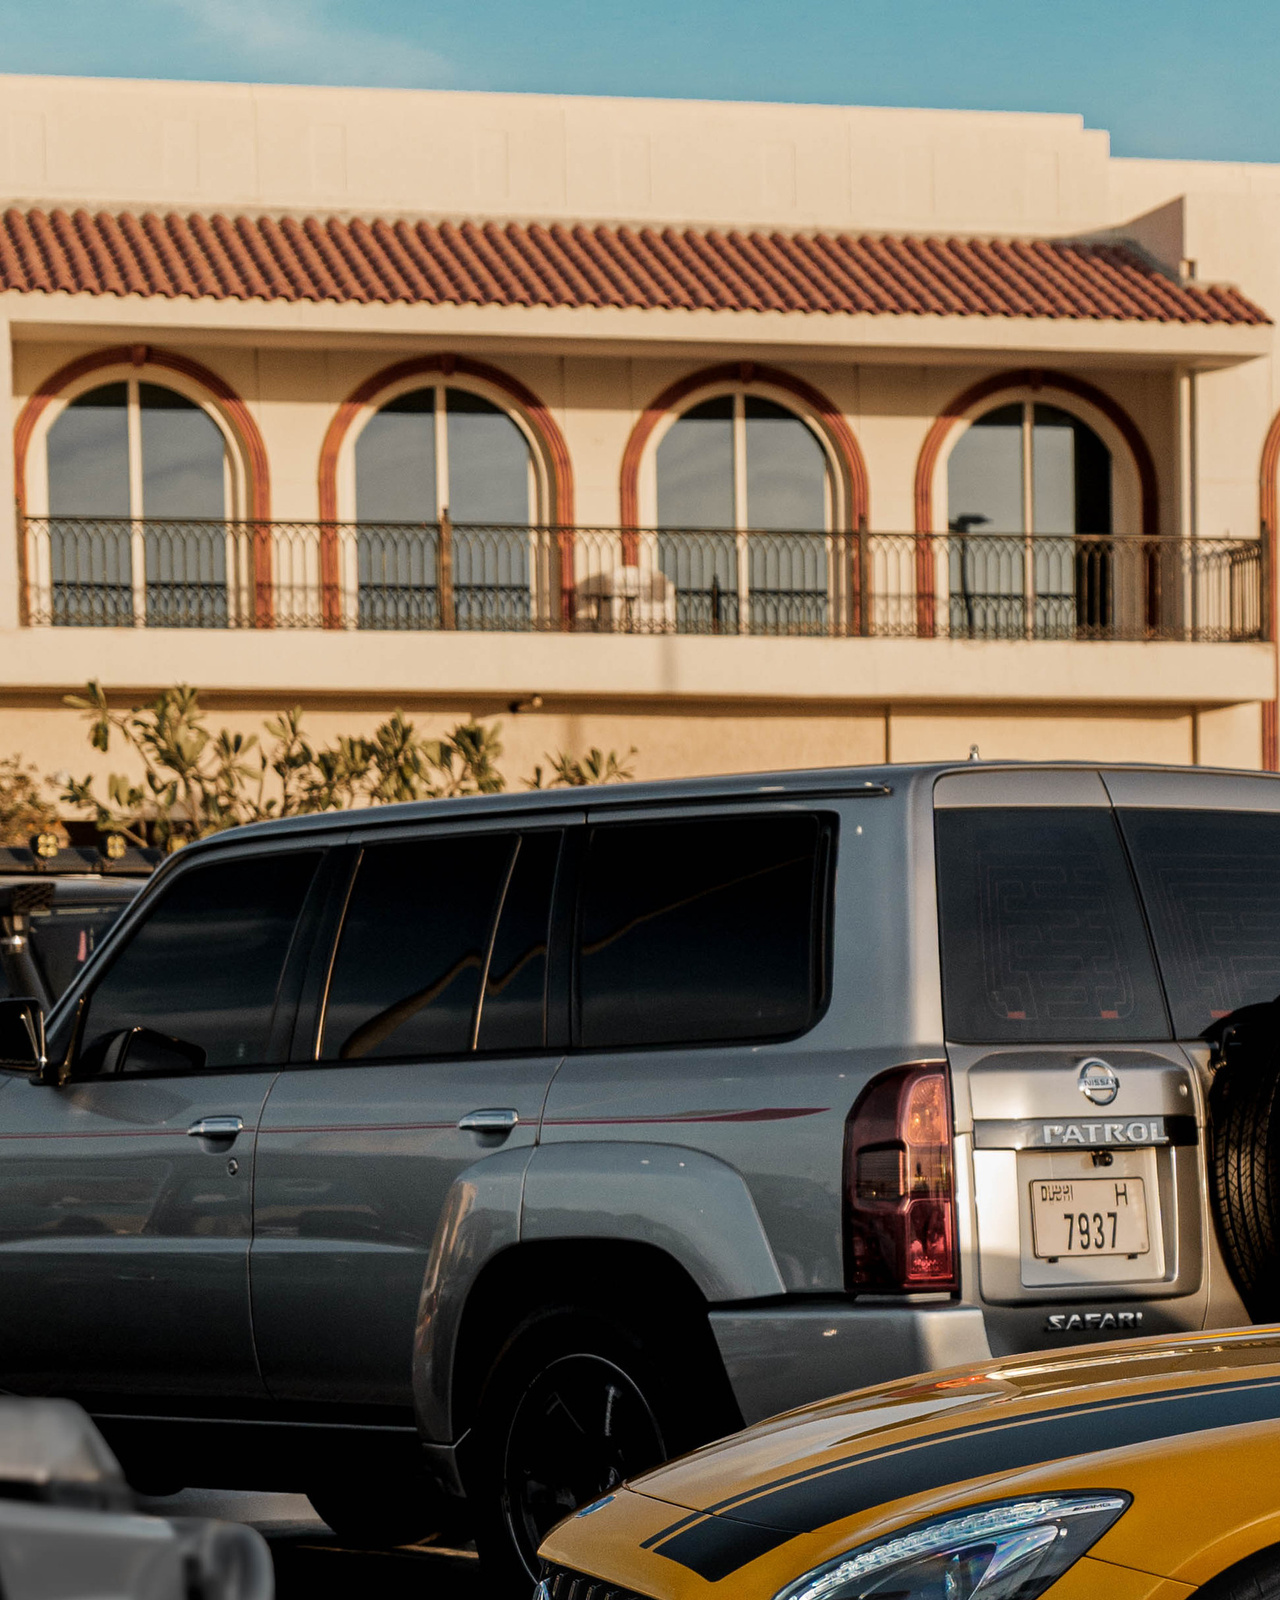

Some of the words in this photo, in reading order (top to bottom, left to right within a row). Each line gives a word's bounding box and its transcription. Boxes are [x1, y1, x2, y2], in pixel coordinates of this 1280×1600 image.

[1043, 1122, 1169, 1144] PATROL
[1114, 1183, 1129, 1206] H
[1063, 1212, 1117, 1251] 7937
[1047, 1312, 1143, 1330] SAFARI
